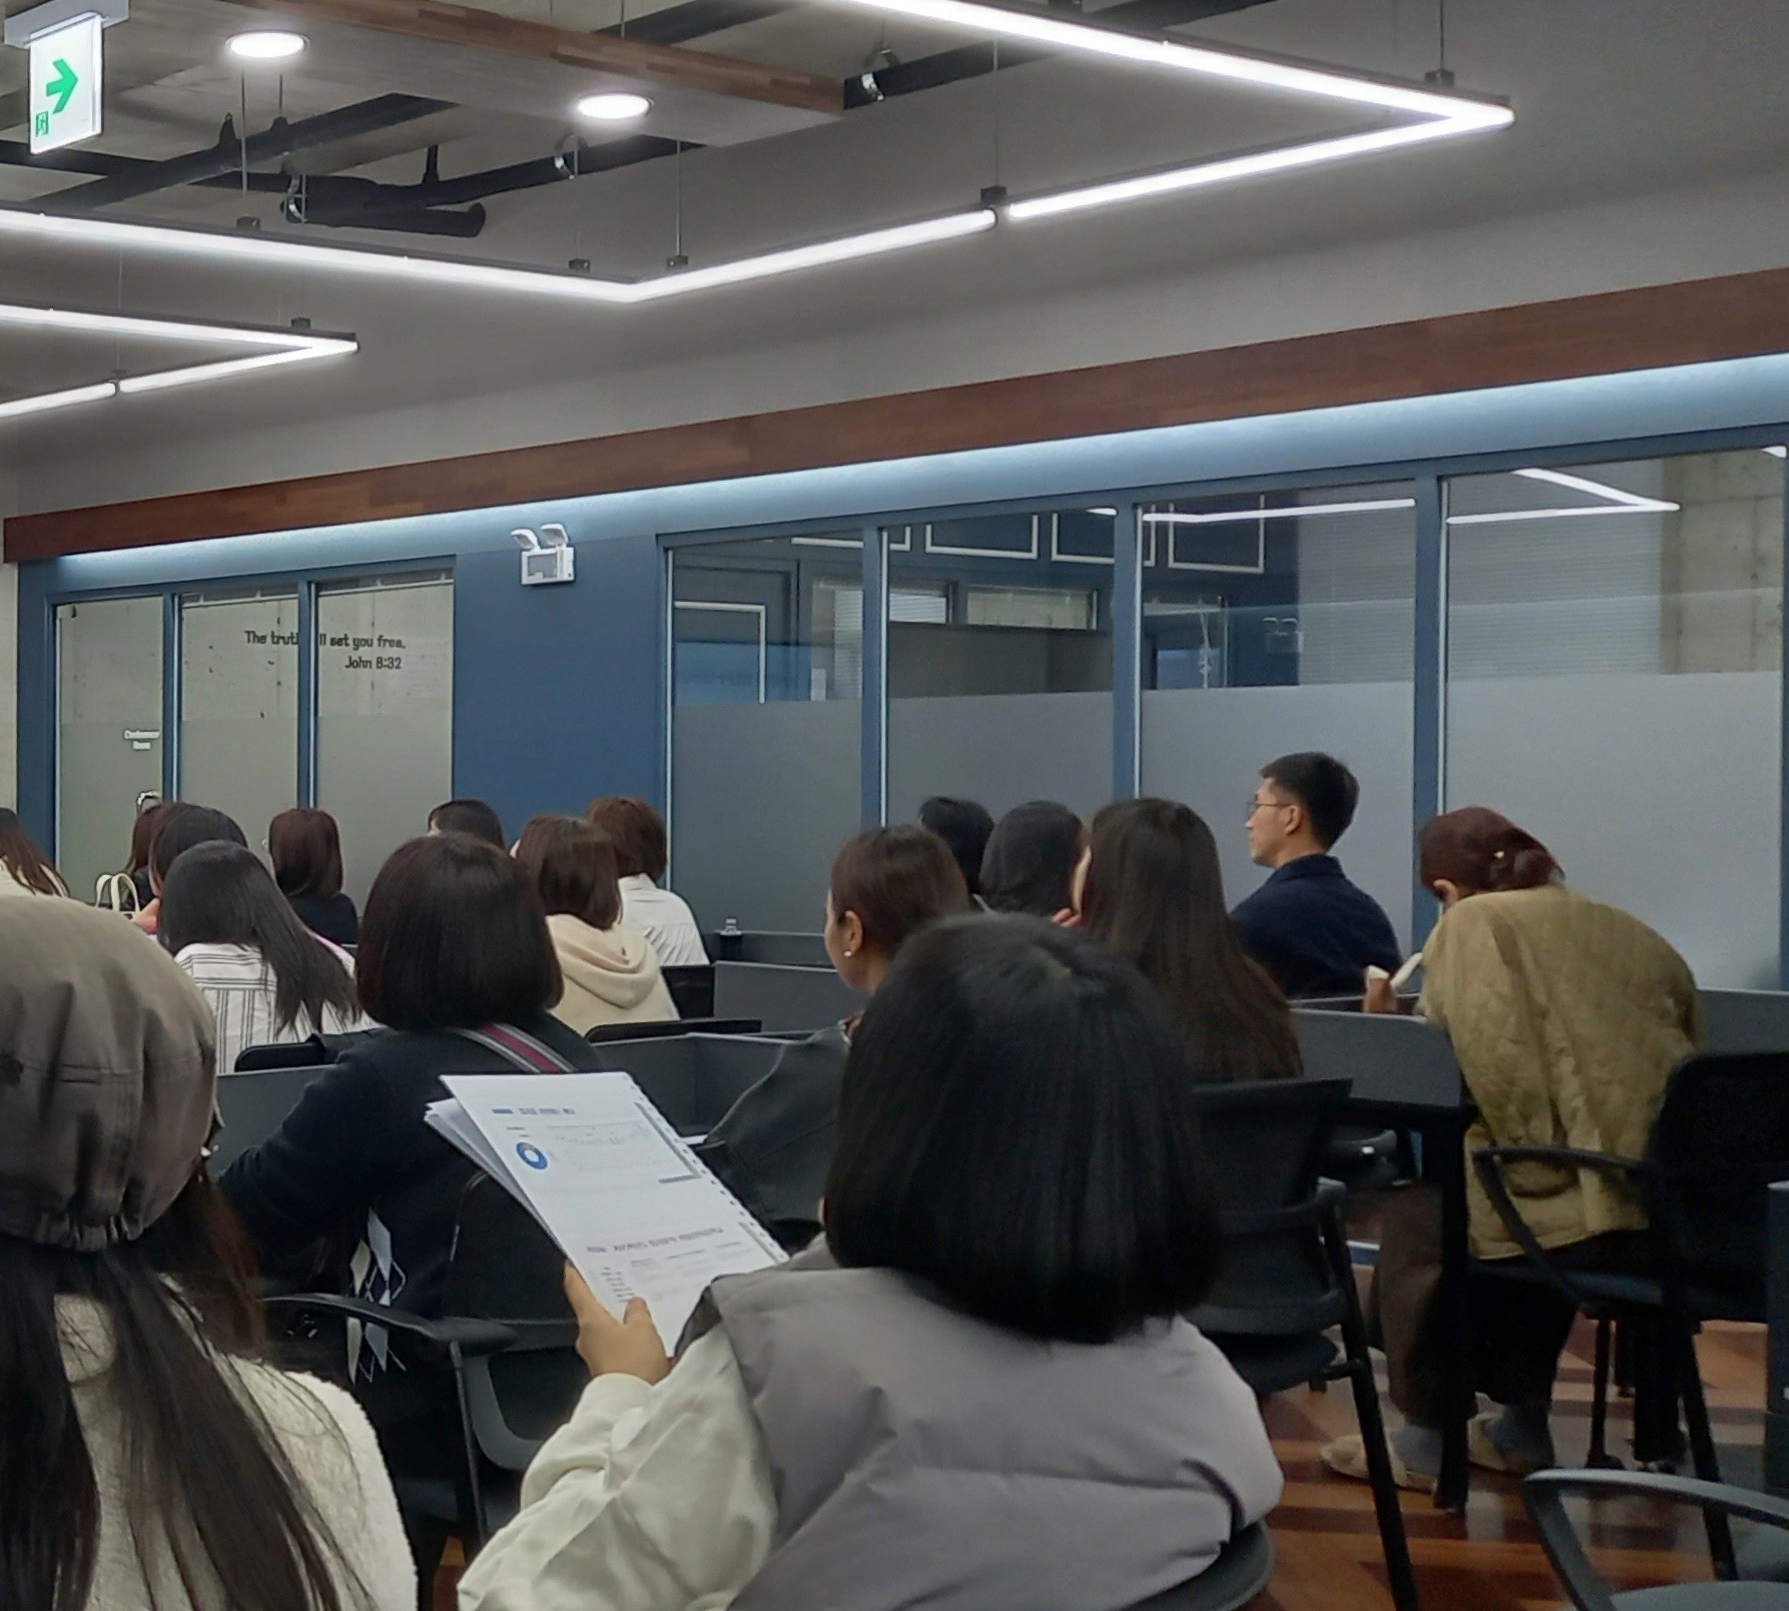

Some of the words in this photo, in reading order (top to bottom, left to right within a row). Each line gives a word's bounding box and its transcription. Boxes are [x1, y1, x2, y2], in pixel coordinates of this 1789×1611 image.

[245, 630, 267, 645] The
[330, 633, 350, 647] set
[353, 637, 374, 651] you
[345, 656, 373, 669] John
[376, 656, 402, 669] 8:32
